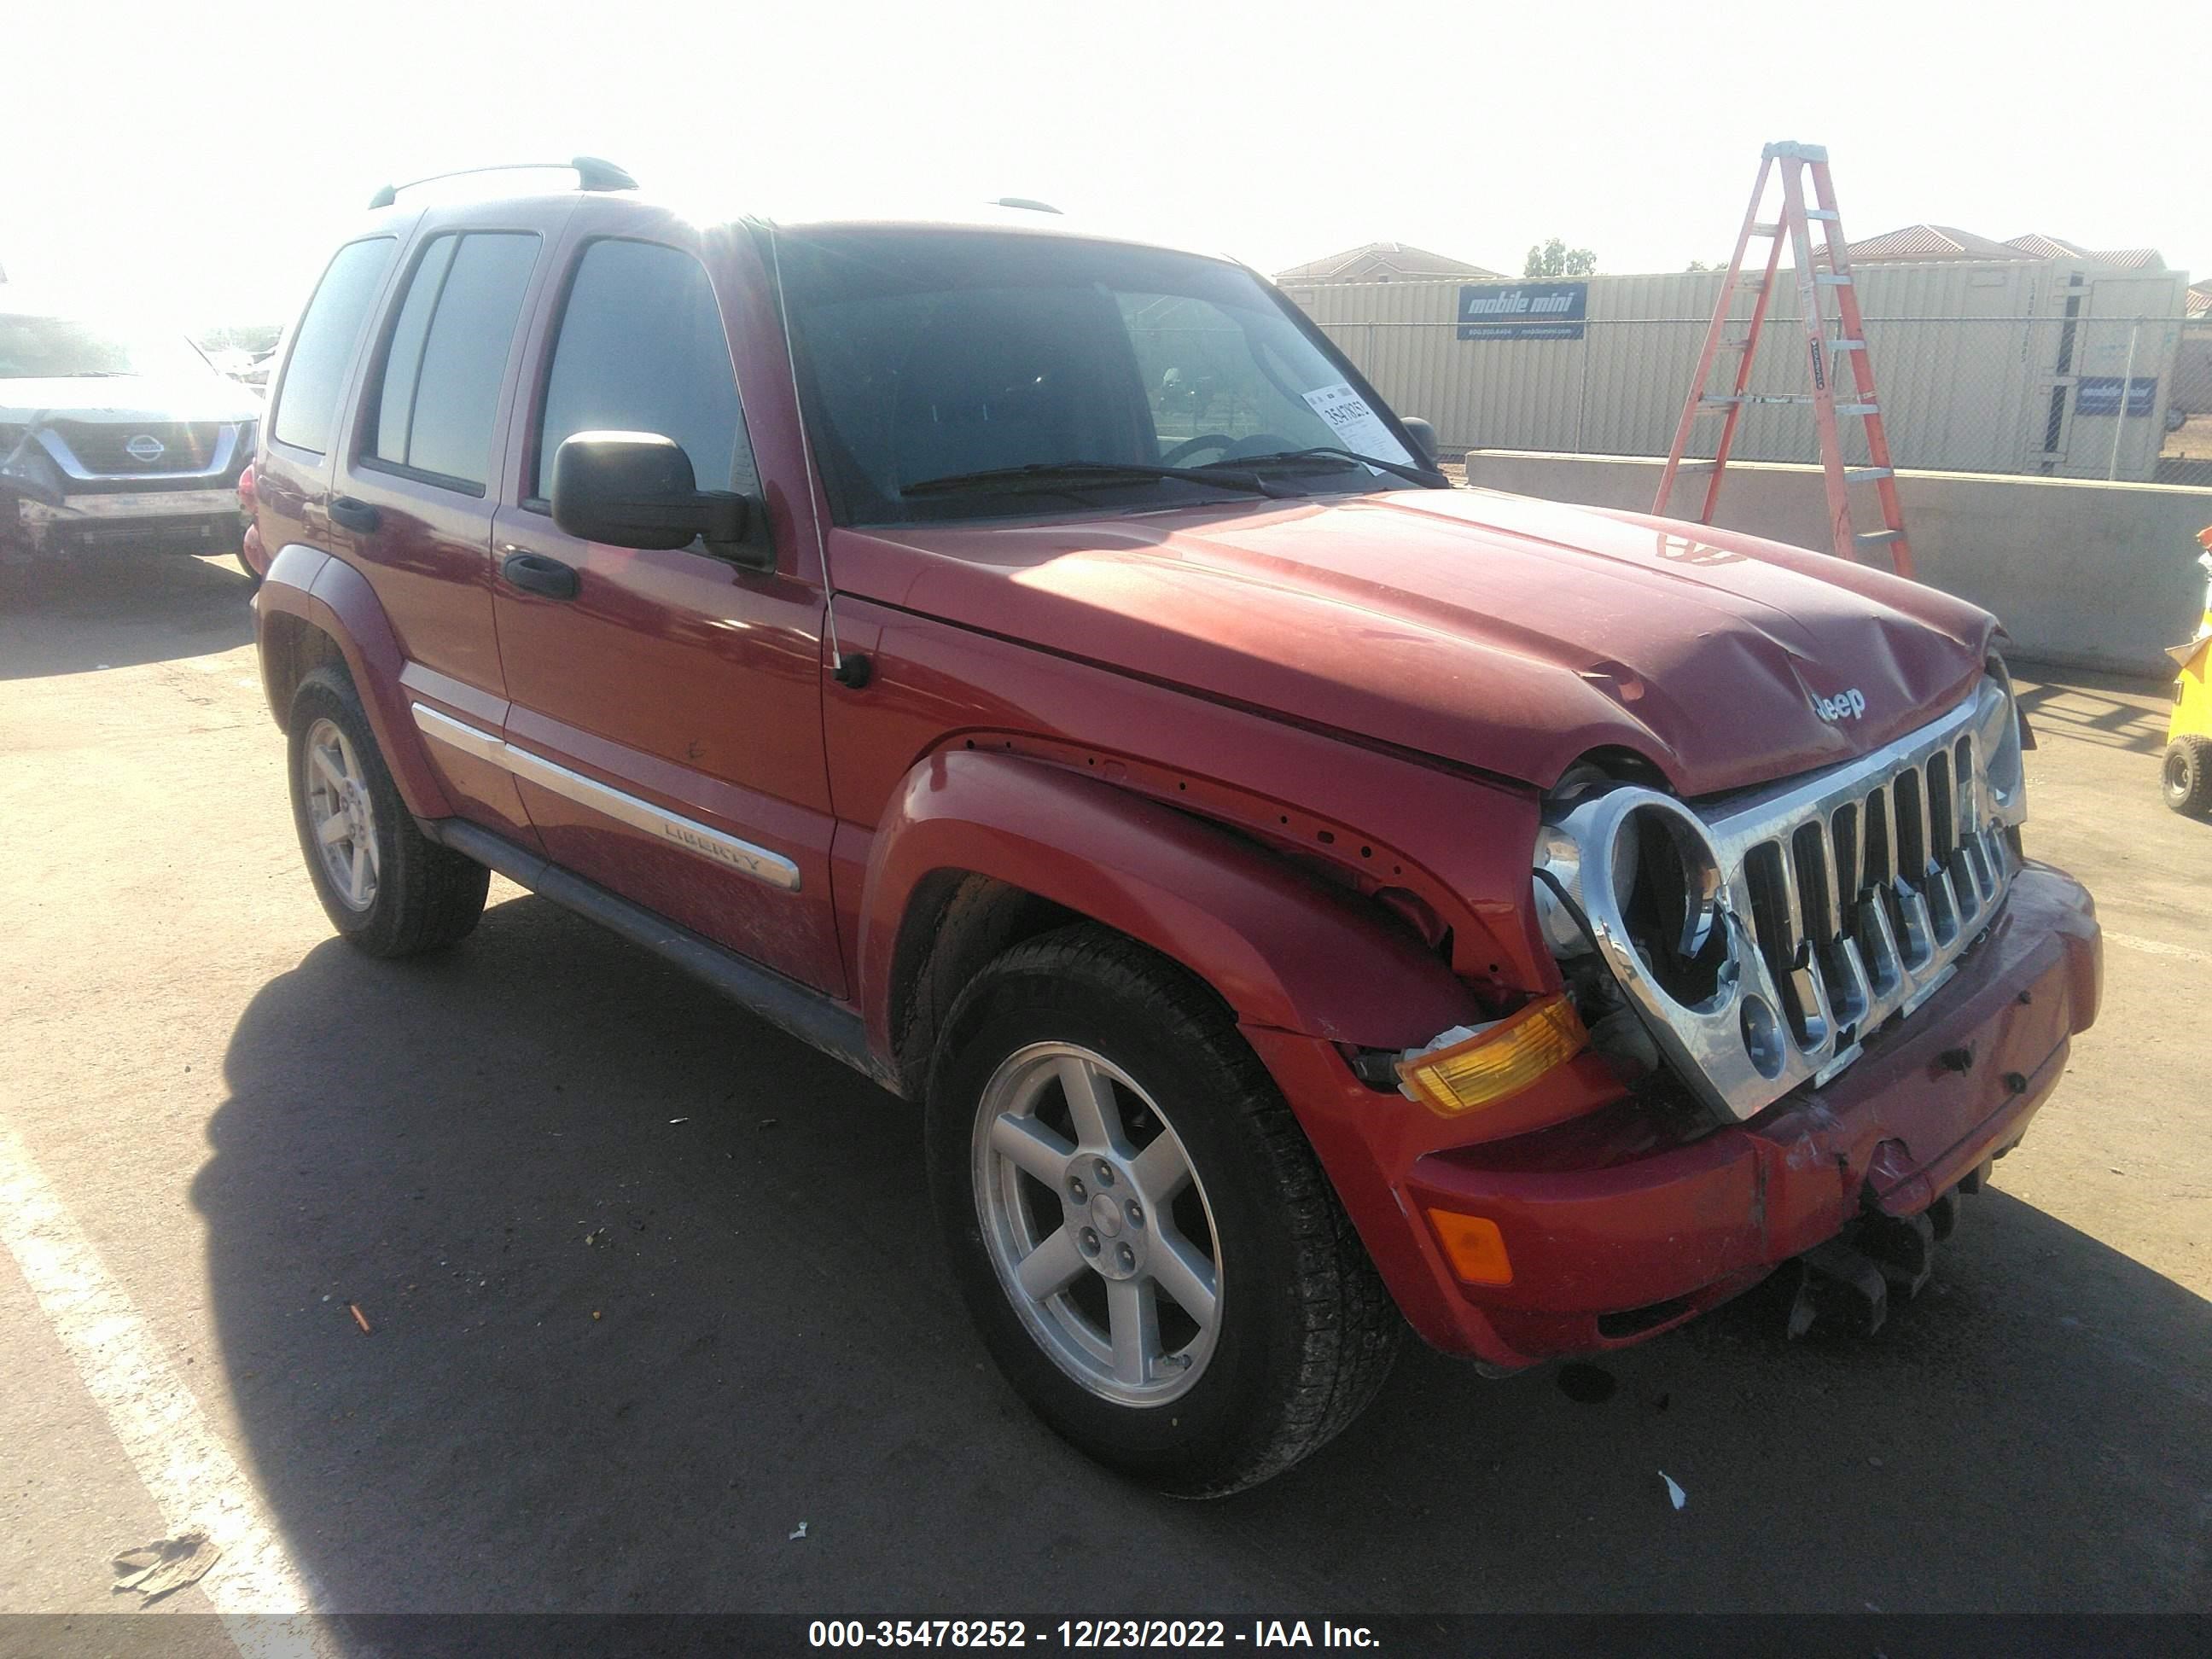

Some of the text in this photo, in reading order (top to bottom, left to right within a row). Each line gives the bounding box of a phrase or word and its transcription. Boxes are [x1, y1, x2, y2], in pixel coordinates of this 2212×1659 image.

[1468, 291, 1575, 313] mobile mini
[1811, 688, 1866, 721] Jeep
[663, 824, 760, 870] LIBERTY
